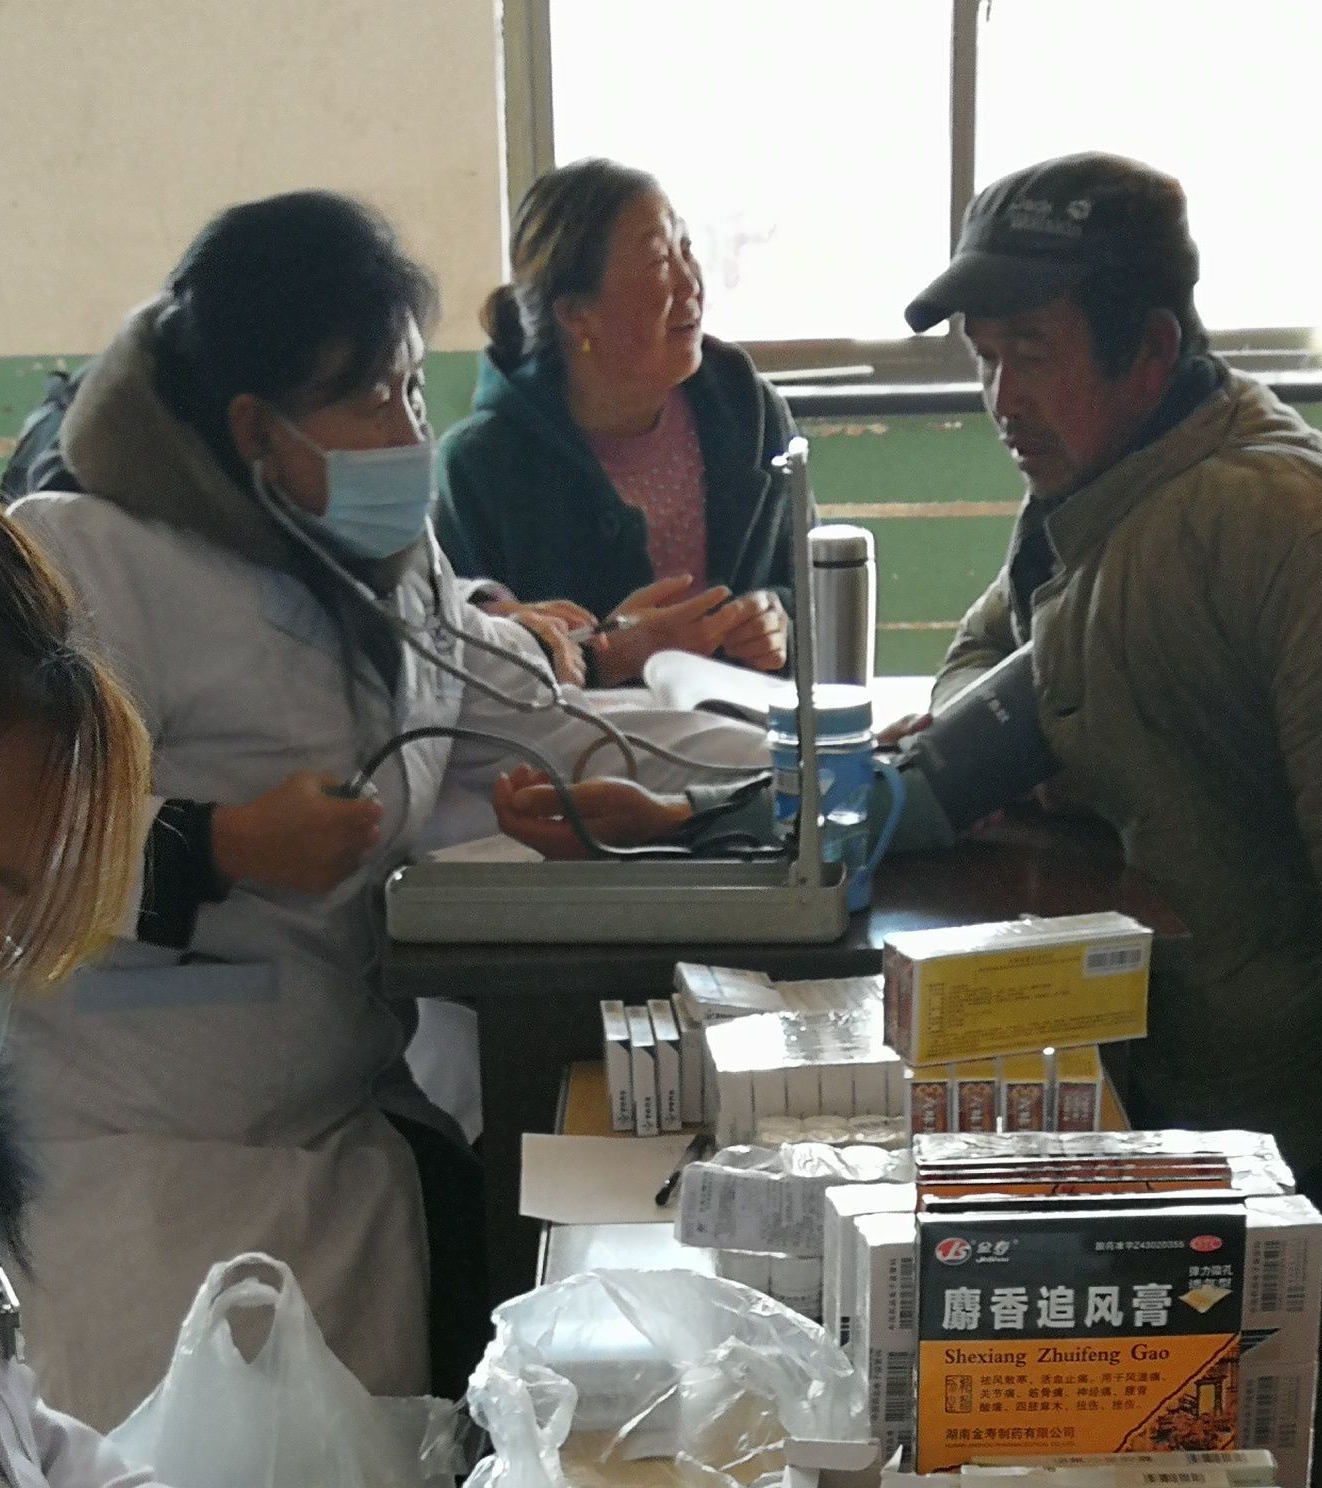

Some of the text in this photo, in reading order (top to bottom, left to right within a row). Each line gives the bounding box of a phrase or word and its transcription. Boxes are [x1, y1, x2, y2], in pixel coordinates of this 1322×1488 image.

[942, 1282, 1173, 1331] 麝香追风膏
[945, 1343, 1170, 1367] Shexiang Zhuifeng Gao
